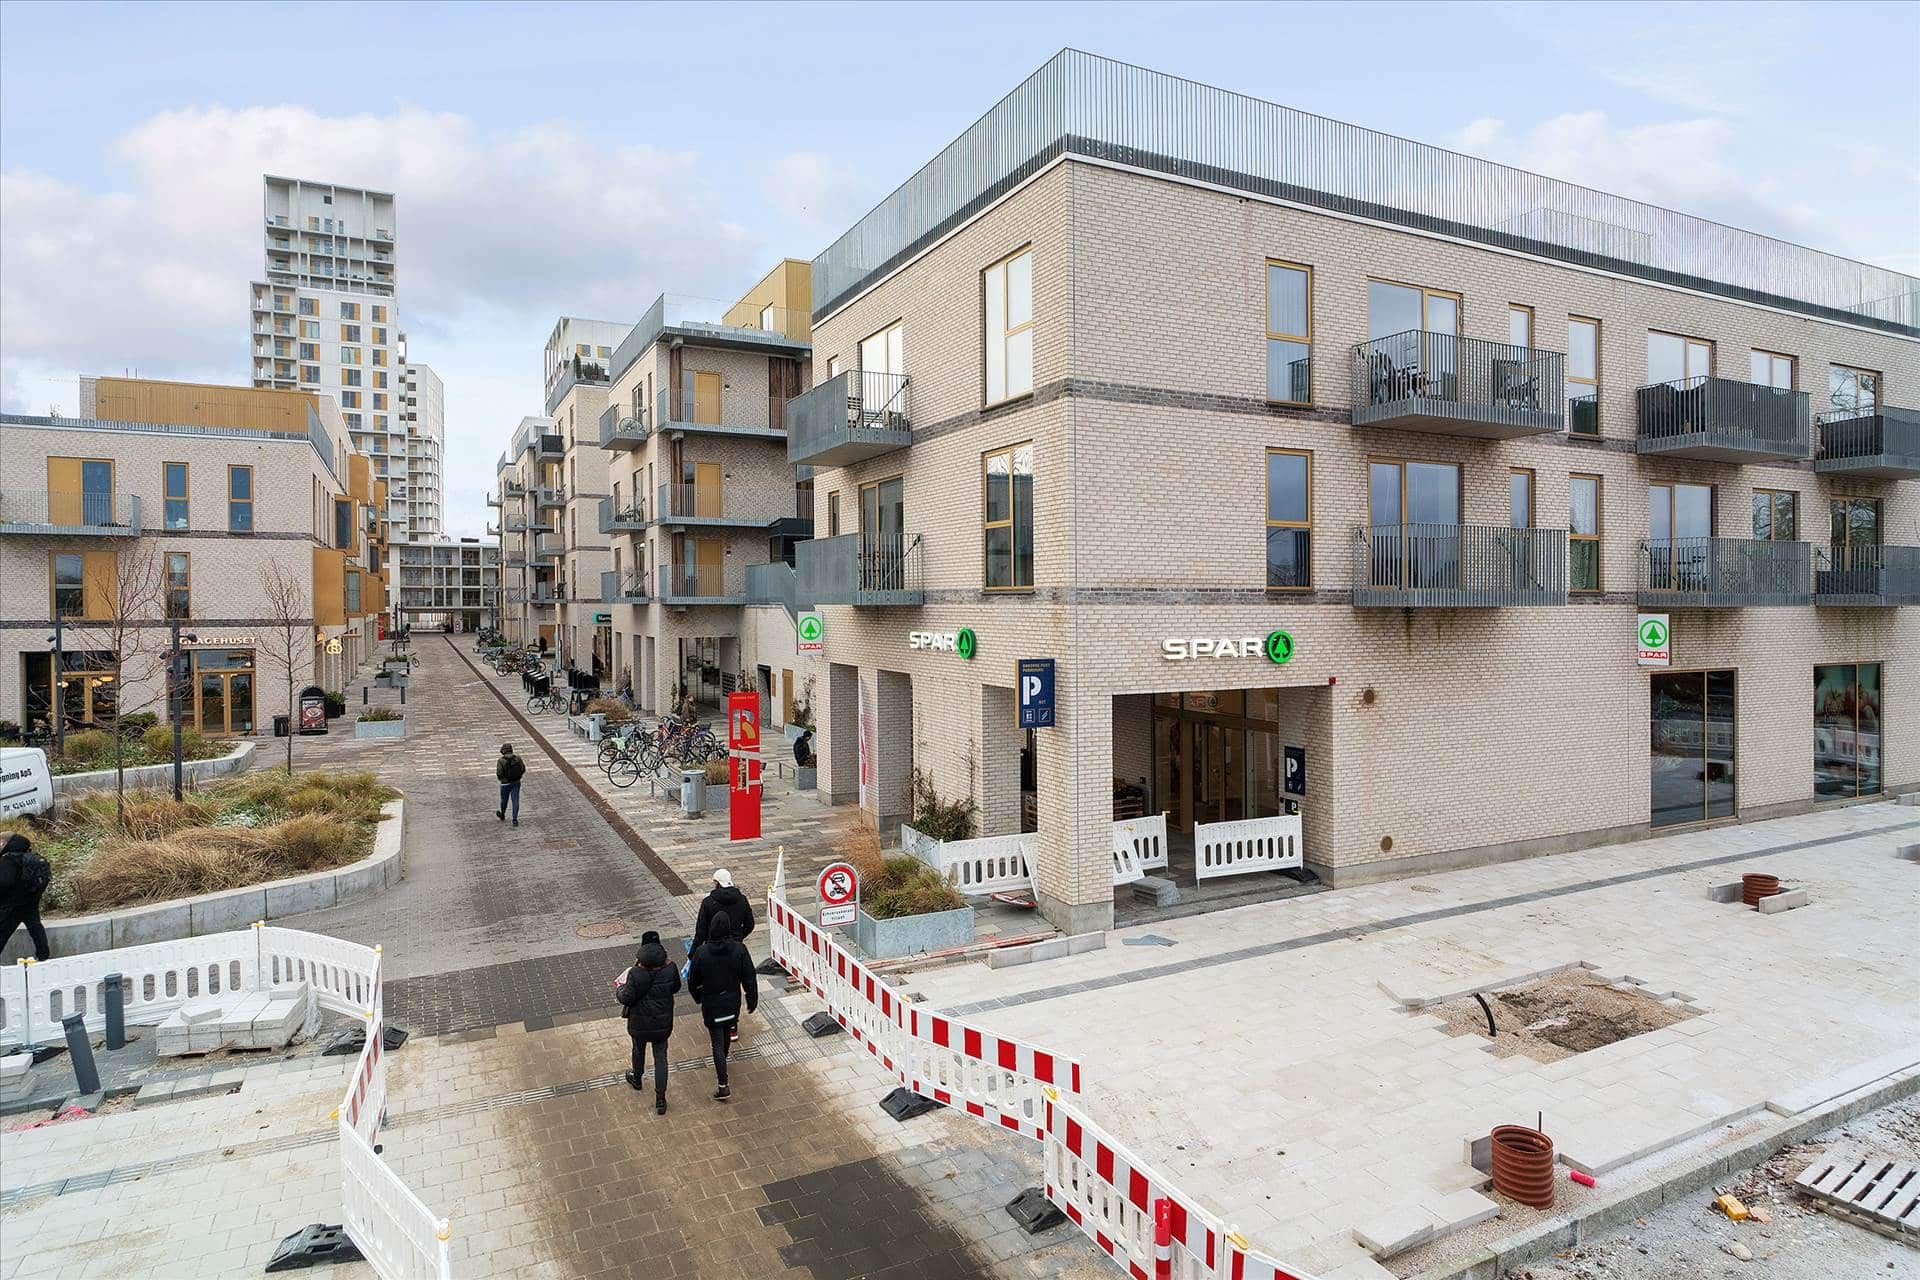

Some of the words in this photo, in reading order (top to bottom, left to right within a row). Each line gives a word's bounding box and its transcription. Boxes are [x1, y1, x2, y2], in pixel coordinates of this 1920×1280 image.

[909, 631, 955, 651] SPAR
[1162, 638, 1263, 659] SPAR
[1639, 651, 1667, 659] SPAR
[1022, 675, 1042, 705] P
[1286, 757, 1298, 778] P
